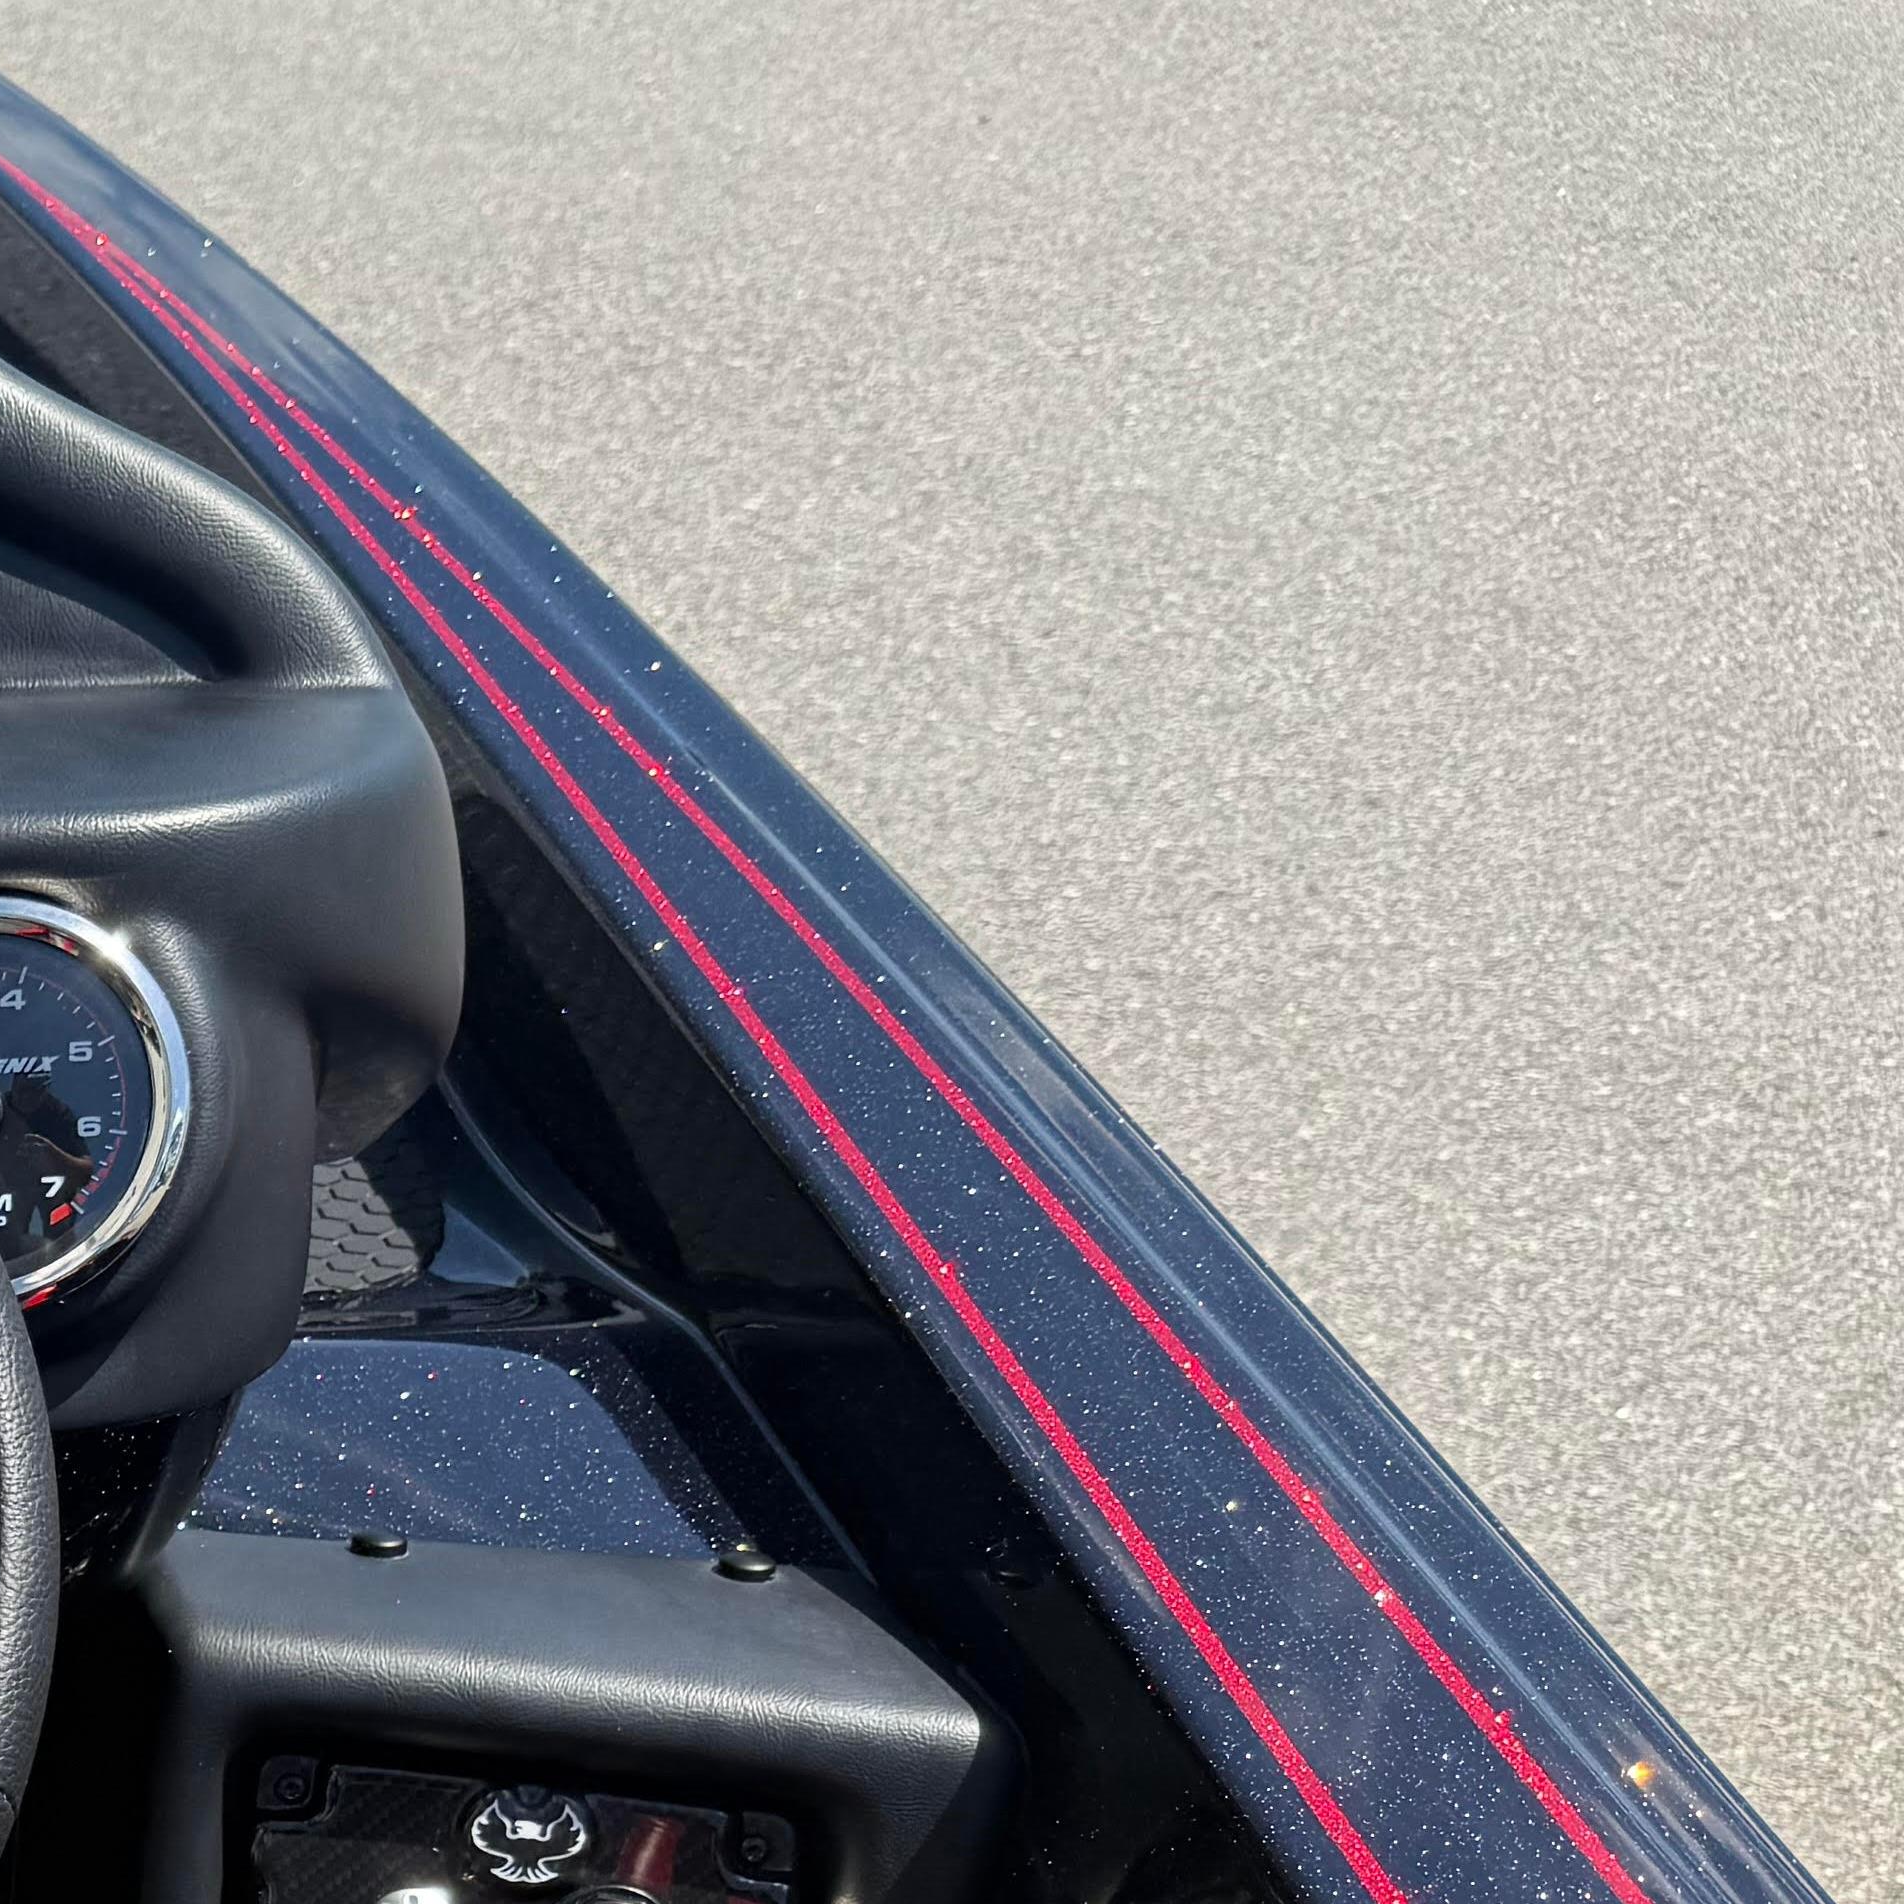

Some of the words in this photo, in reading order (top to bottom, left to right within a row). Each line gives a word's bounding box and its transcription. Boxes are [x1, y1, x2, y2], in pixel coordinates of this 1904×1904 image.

[0, 989, 26, 1010] 4
[68, 1041, 93, 1062] 5
[77, 1116, 102, 1138] 6
[40, 1175, 66, 1198] 7
